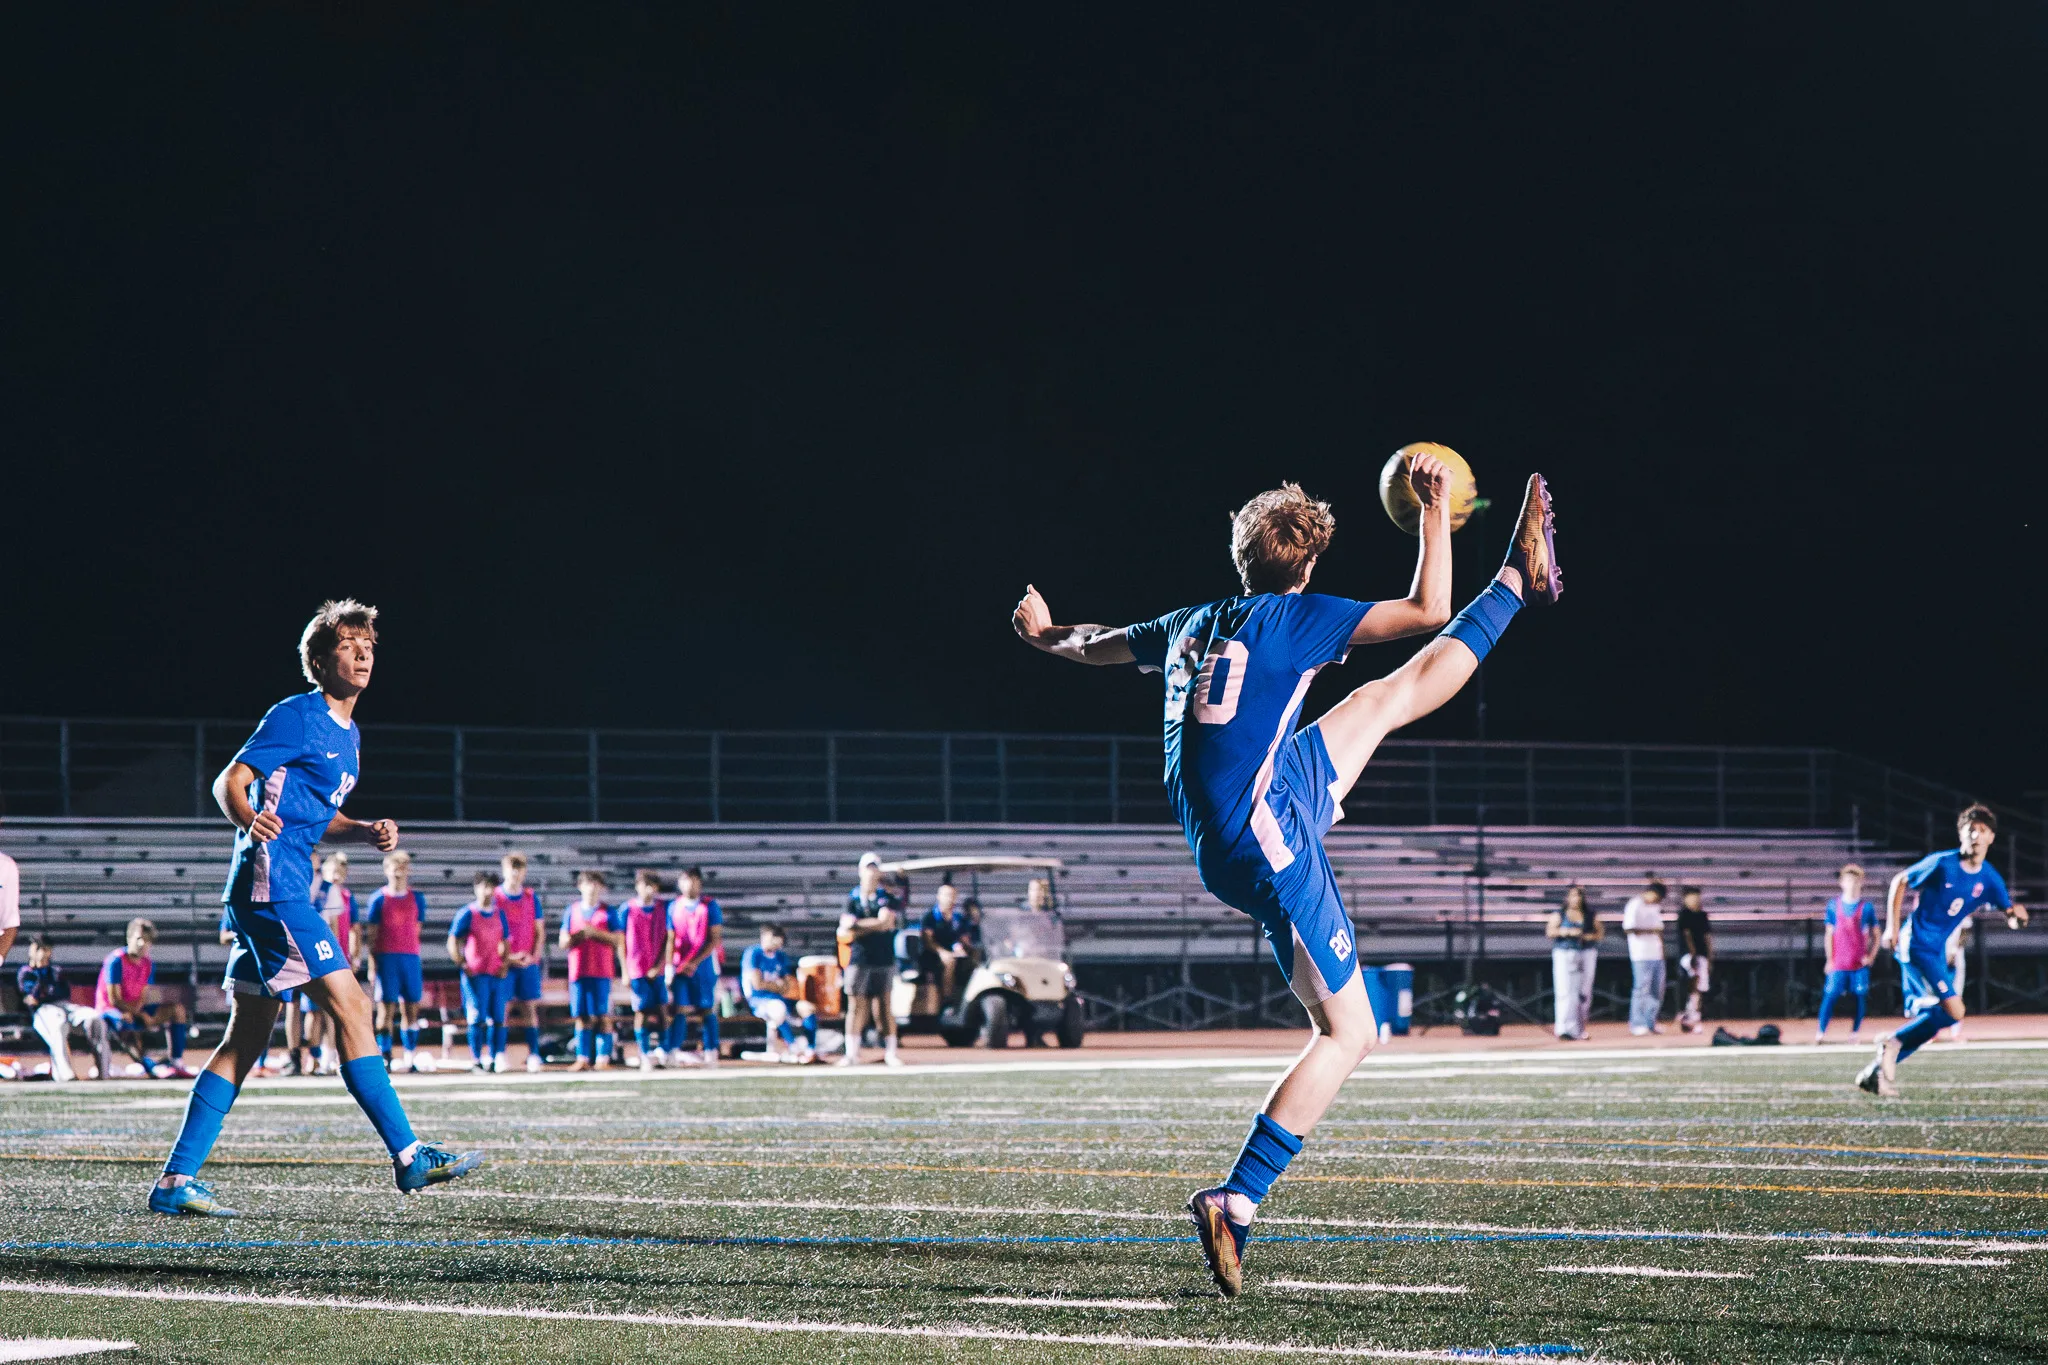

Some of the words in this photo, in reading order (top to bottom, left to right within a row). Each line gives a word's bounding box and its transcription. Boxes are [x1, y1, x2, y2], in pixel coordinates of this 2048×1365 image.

[330, 771, 355, 808] 19
[1947, 897, 1964, 916] 9
[314, 940, 334, 961] 19
[1329, 929, 1352, 962] 20
